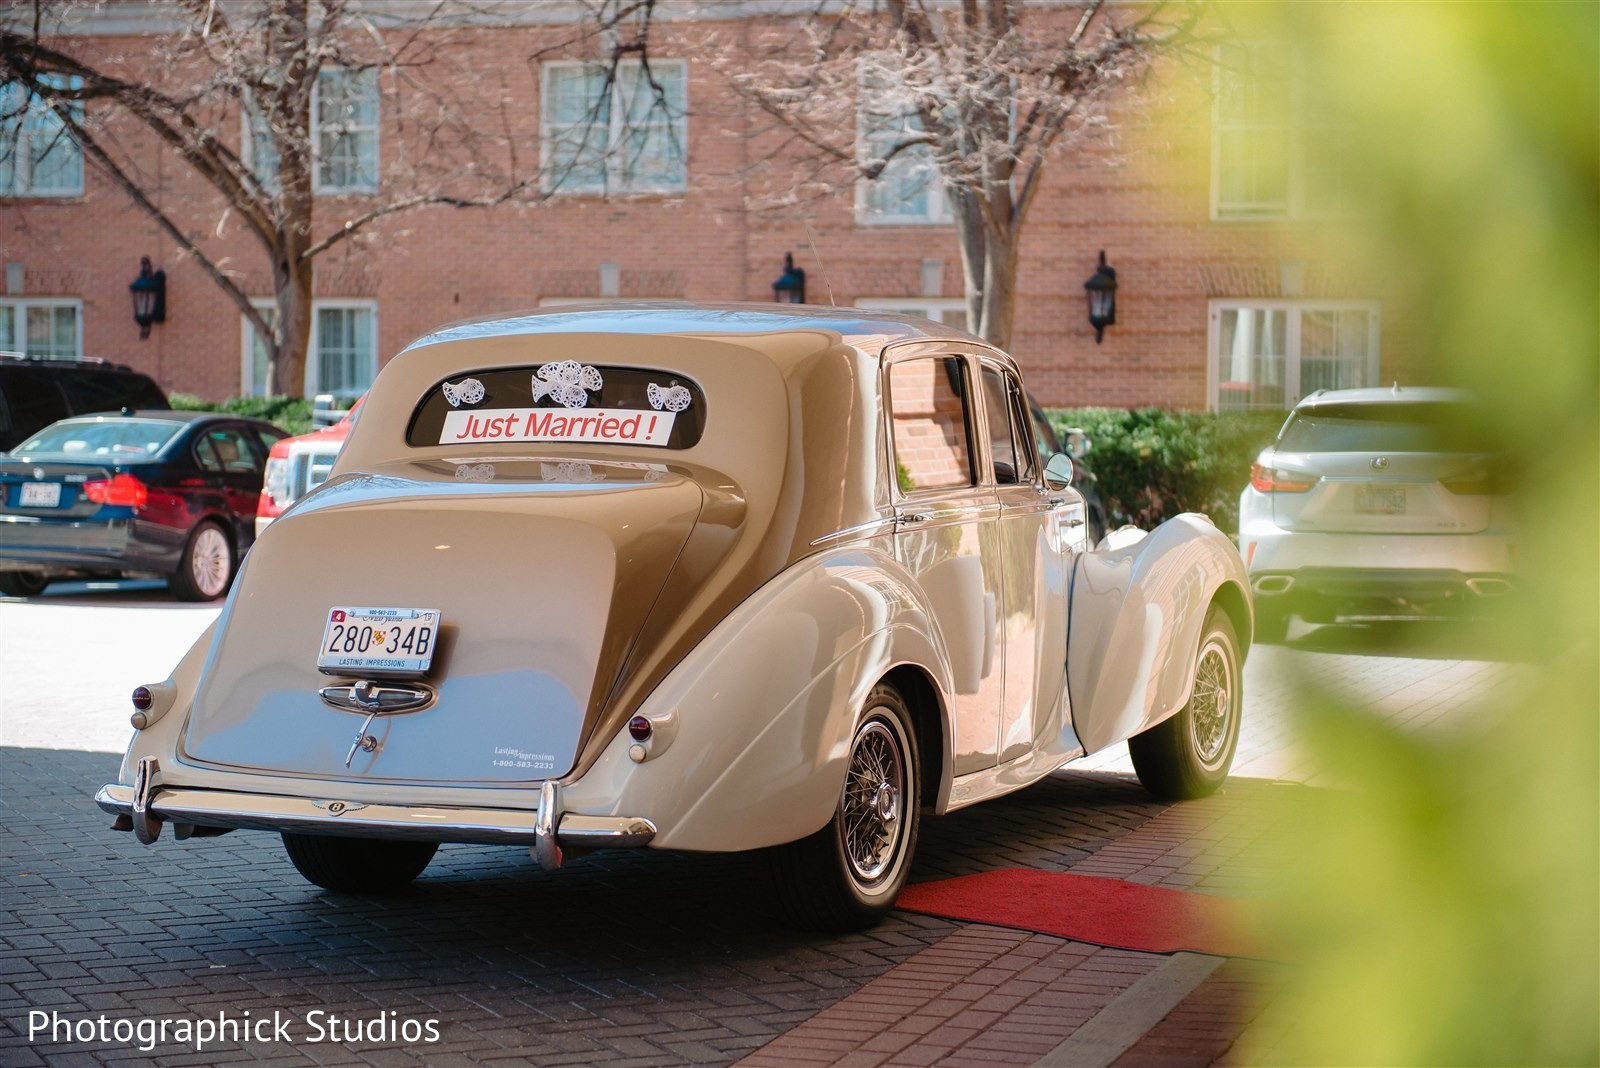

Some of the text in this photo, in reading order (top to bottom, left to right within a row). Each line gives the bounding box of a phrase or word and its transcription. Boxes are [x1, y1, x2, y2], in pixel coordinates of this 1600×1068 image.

[456, 413, 519, 439] Just
[523, 411, 642, 440] Married
[328, 624, 432, 656] 280 34B
[338, 658, 406, 668] LASTING IMPRESSIONS
